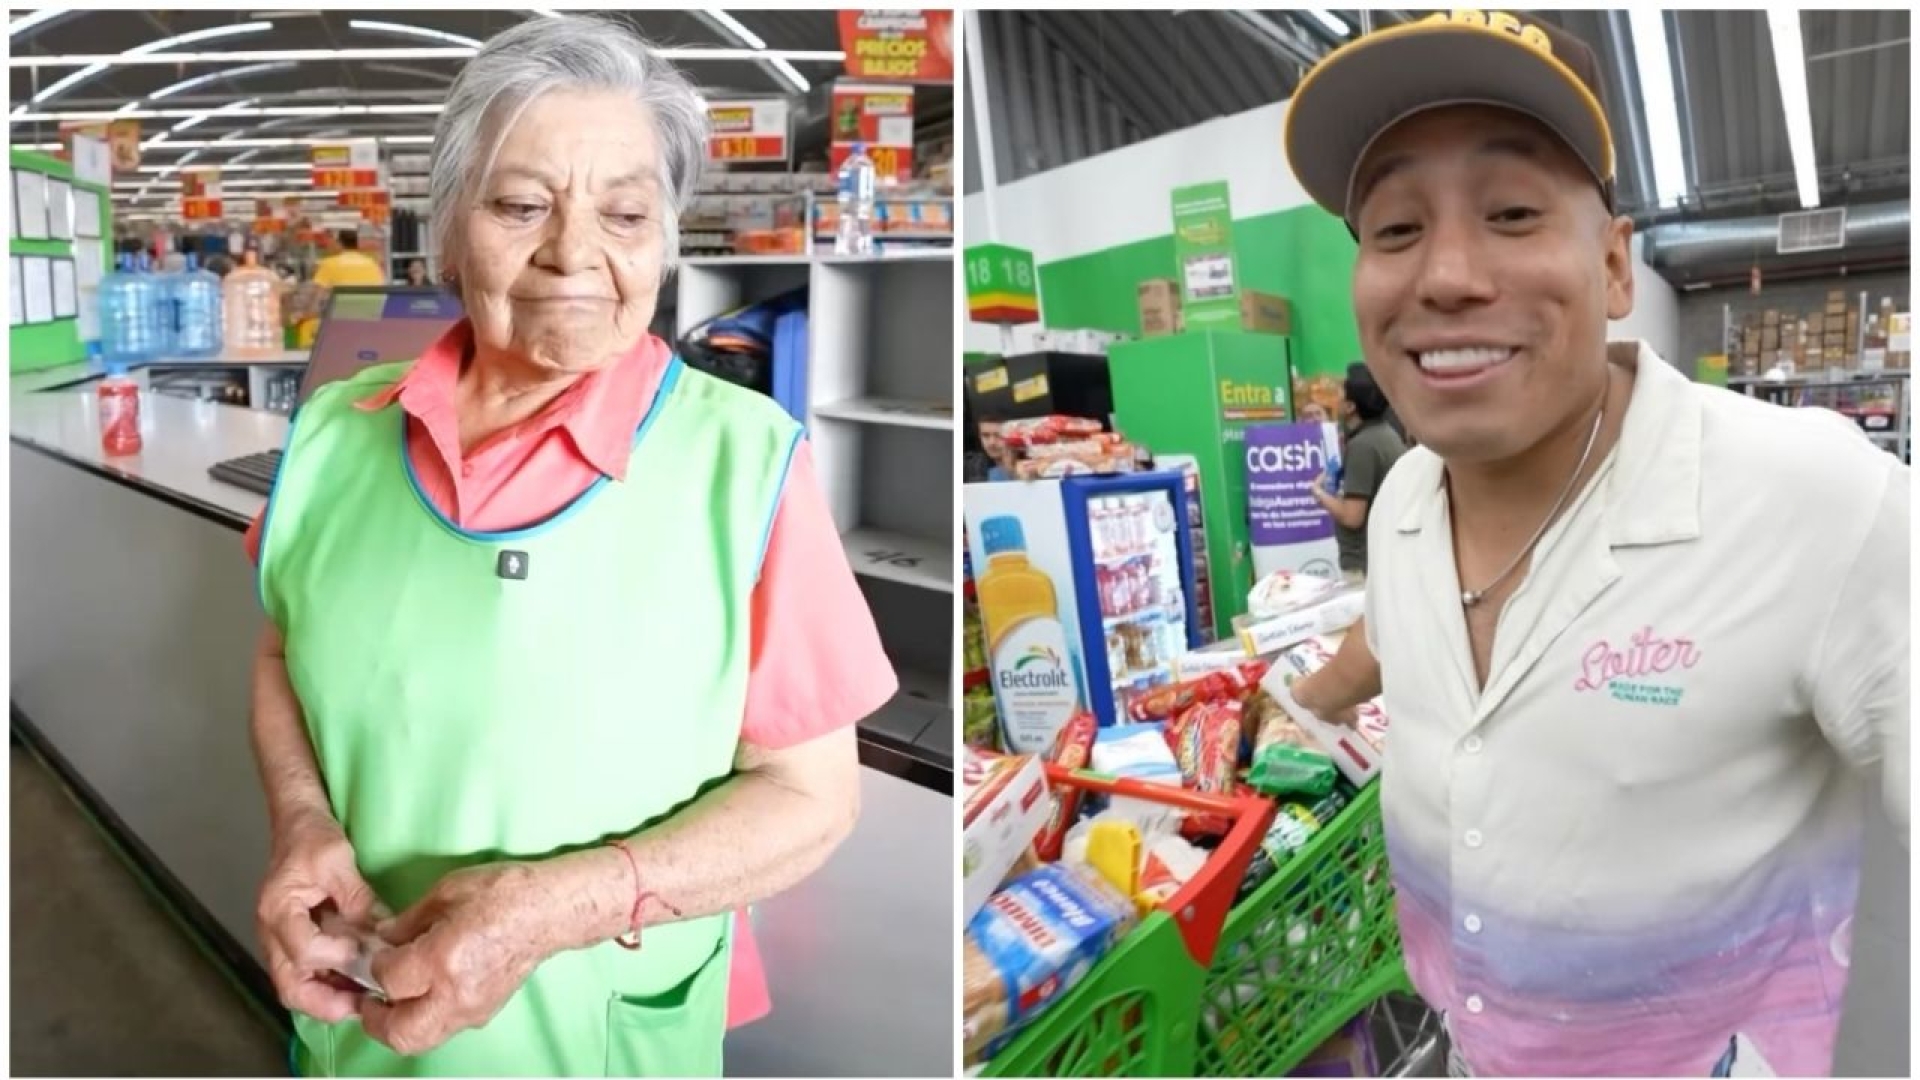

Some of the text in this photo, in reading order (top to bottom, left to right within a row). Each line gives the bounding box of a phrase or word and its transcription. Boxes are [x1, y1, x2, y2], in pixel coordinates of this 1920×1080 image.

[968, 258, 991, 286] 18
[1002, 259, 1032, 288] 18
[1221, 380, 1285, 403] Entra a
[1574, 625, 1702, 691] Loiter
[1000, 669, 1068, 689] Electrolit
